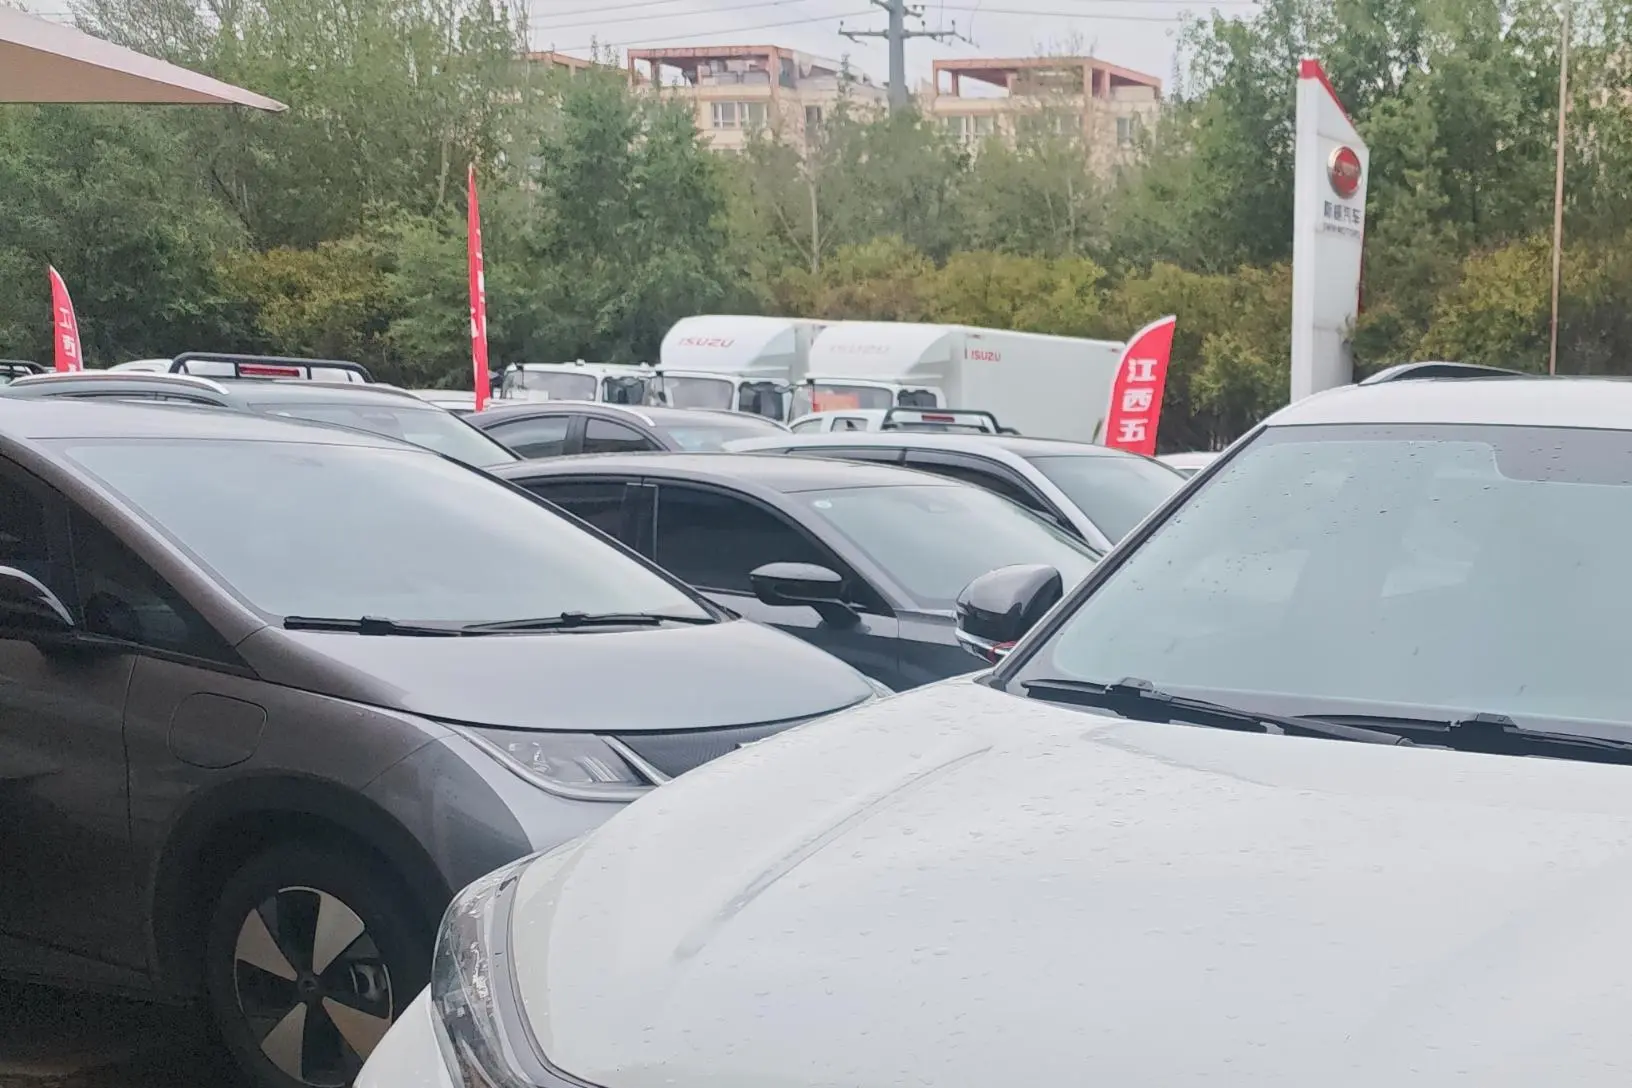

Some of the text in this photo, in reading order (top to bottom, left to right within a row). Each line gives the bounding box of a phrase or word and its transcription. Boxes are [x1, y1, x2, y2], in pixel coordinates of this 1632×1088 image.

[679, 337, 735, 348] ISUZU
[970, 350, 1001, 362] ISUZU
[1116, 358, 1157, 443] 江西五
